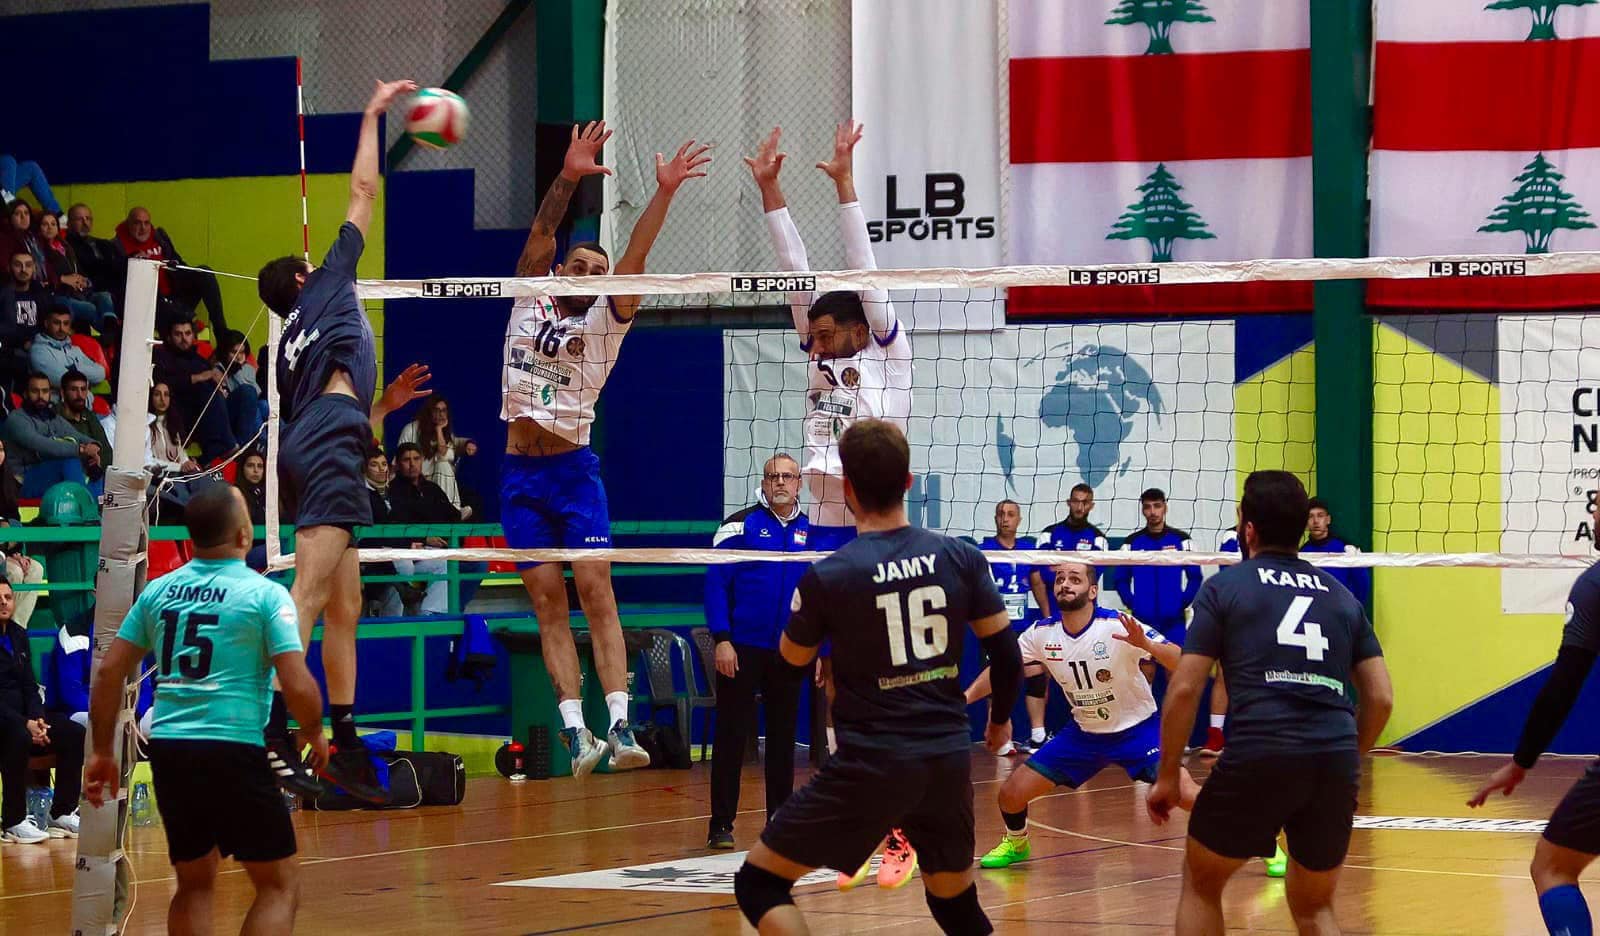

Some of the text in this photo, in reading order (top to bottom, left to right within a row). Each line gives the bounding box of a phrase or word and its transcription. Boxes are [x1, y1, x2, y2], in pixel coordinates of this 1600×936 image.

[886, 172, 965, 219] LB
[866, 216, 995, 242] SPORTS
[1070, 270, 1158, 285] LB SPORTS
[1430, 261, 1524, 276] LB SPORTS
[423, 283, 500, 296] LB SPORTS
[732, 278, 814, 291] LB SPORTS
[534, 320, 567, 358] 16
[1572, 388, 1600, 417] C
[1573, 468, 1600, 479] PRO
[872, 553, 937, 583] JAMY
[1257, 567, 1330, 593] KARL
[166, 585, 228, 603] SIMON
[875, 584, 949, 667] 16
[1276, 595, 1330, 662] 4
[160, 609, 220, 678] 15
[1068, 660, 1094, 690] 11
